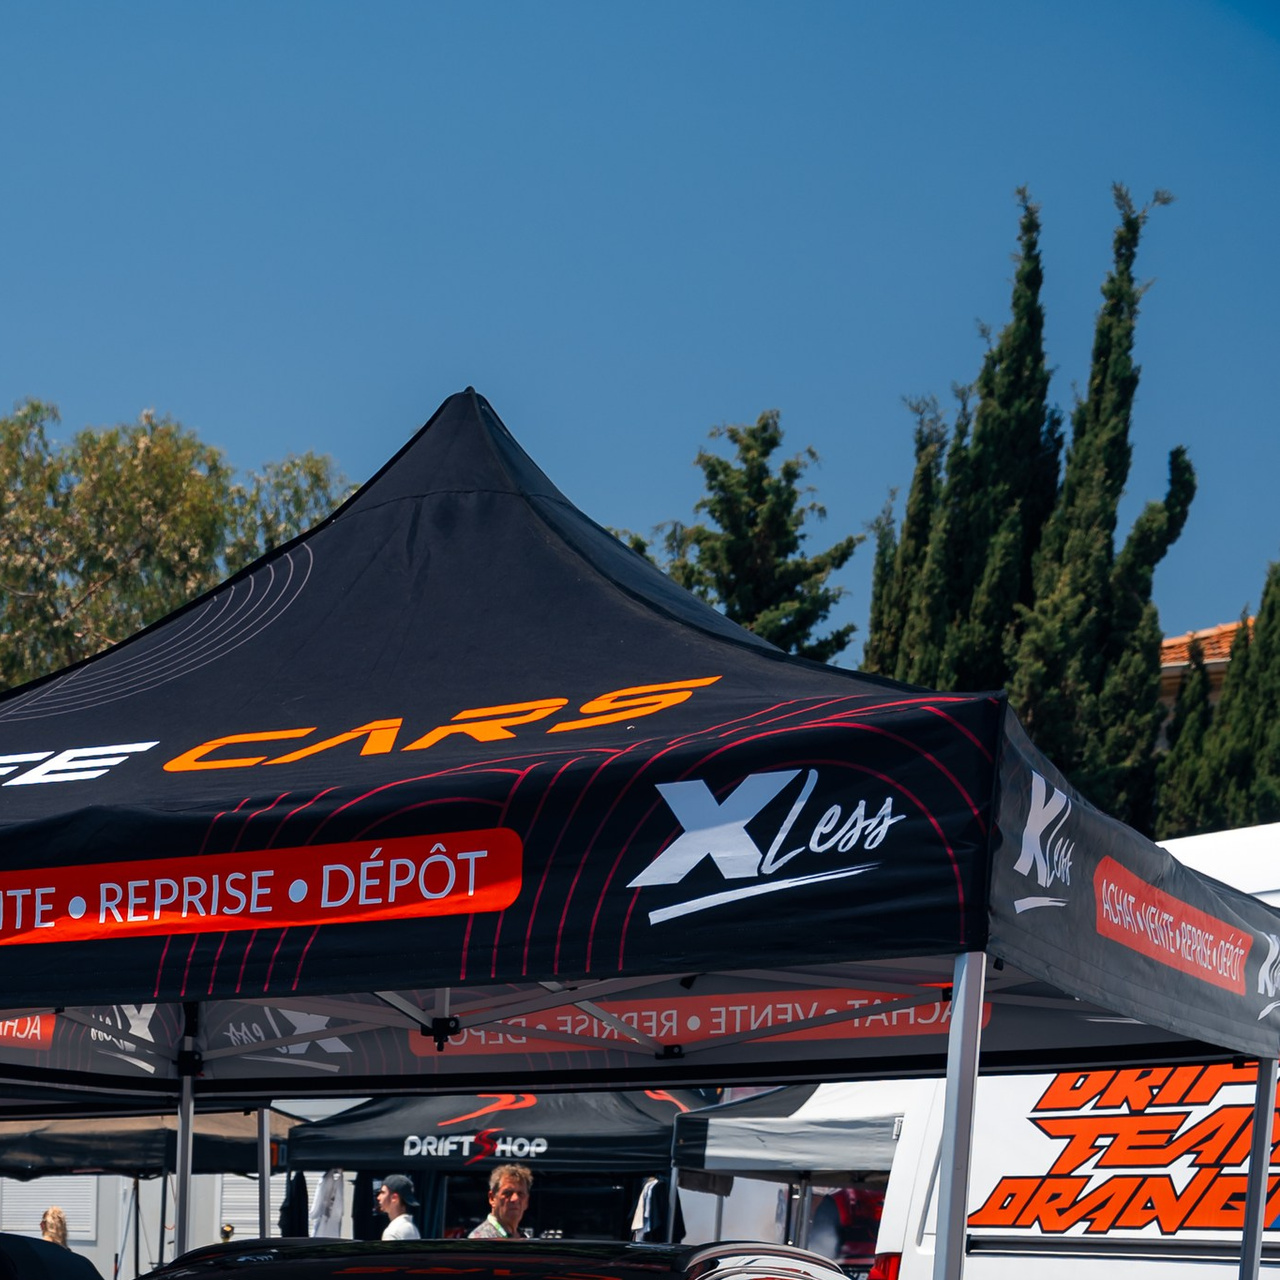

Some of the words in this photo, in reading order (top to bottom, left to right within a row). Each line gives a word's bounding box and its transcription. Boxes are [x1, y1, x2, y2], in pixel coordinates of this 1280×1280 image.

[162, 675, 723, 773] CARS
[98, 869, 275, 924] REPRISE
[320, 844, 489, 911] DÉPÔT
[1102, 879, 1138, 934] ACHAT
[1141, 903, 1175, 954] VENTE
[1181, 921, 1214, 970] REPRISE
[1216, 933, 1245, 982] DÉPÔT
[1030, 1062, 1258, 1113] DRIF
[966, 1166, 1280, 1235] ORANG
